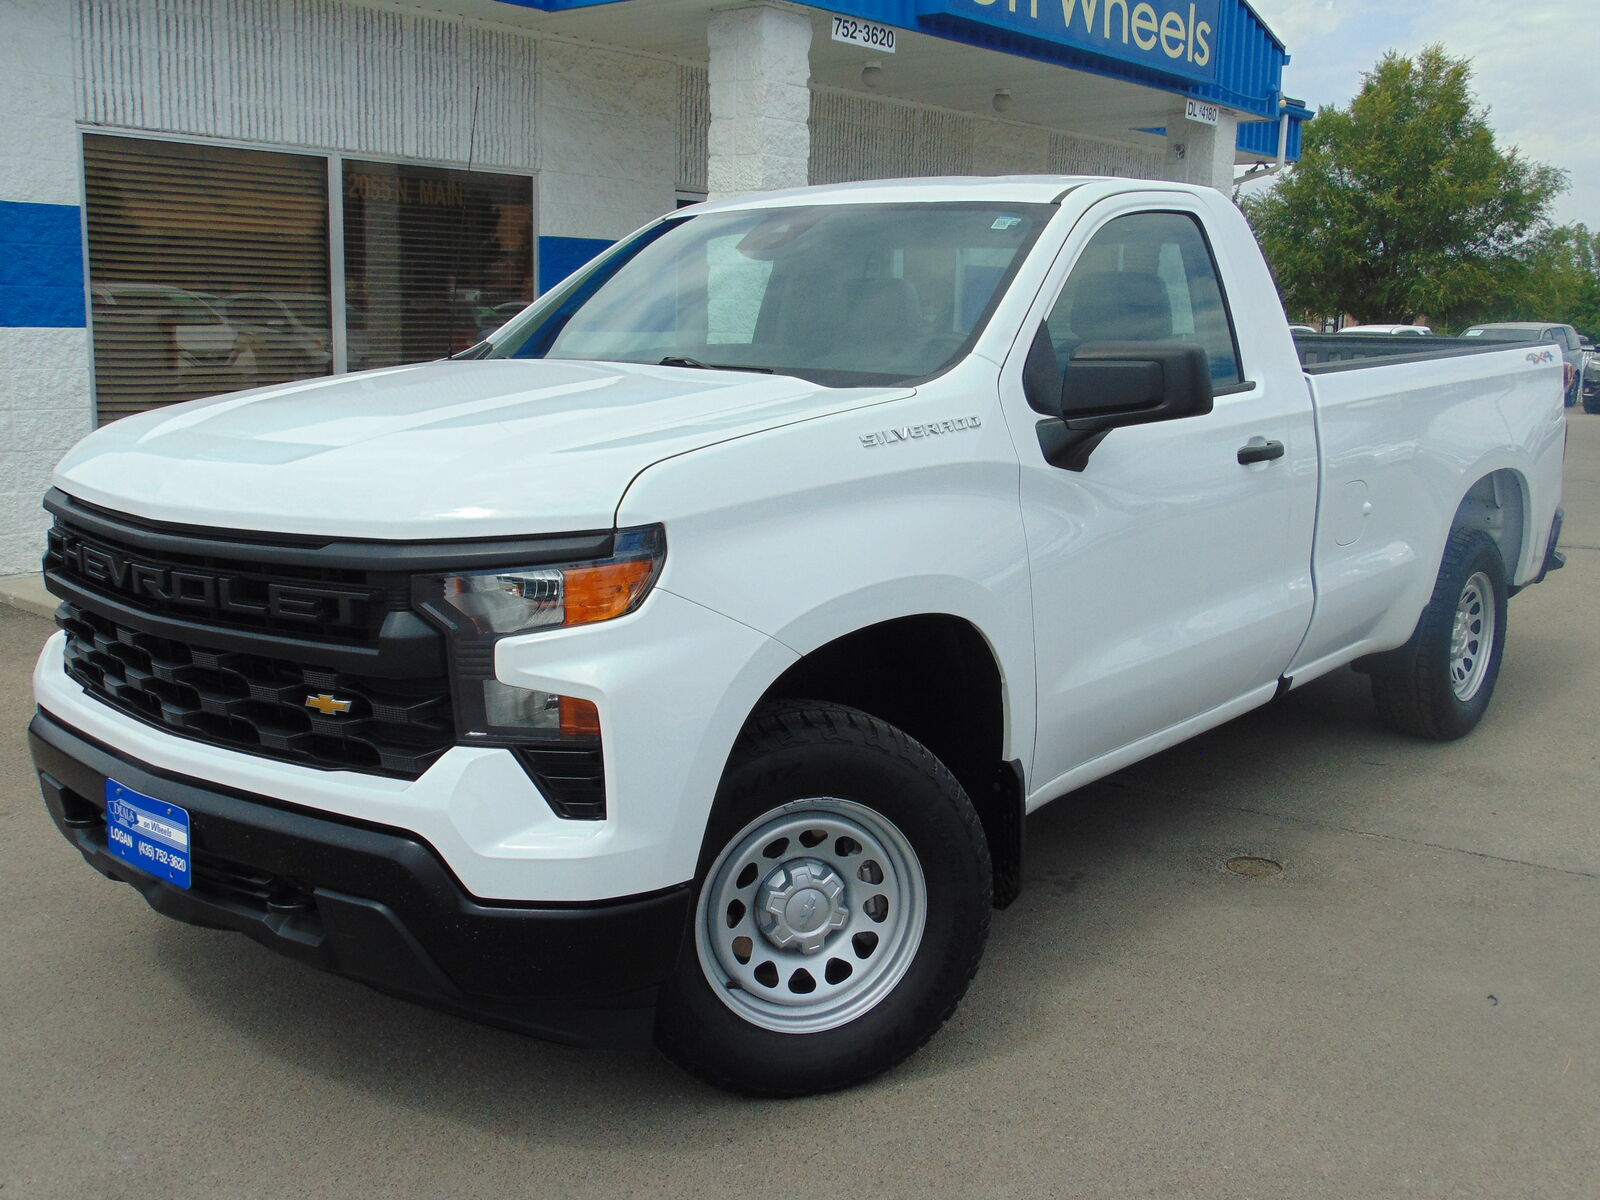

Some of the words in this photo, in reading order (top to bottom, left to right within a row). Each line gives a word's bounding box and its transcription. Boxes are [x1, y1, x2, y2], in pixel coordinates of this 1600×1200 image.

[833, 17, 895, 49] 752-3620
[1188, 102, 1197, 117] DL
[420, 179, 464, 207] MAIN
[859, 416, 981, 448] SILVERADO
[49, 526, 378, 624] CHEVROLET
[113, 802, 135, 823] DEALS
[151, 821, 173, 838] Wheels
[110, 826, 133, 849] LOGAN
[138, 841, 155, 861] (435)
[155, 848, 187, 872] 752-3620
